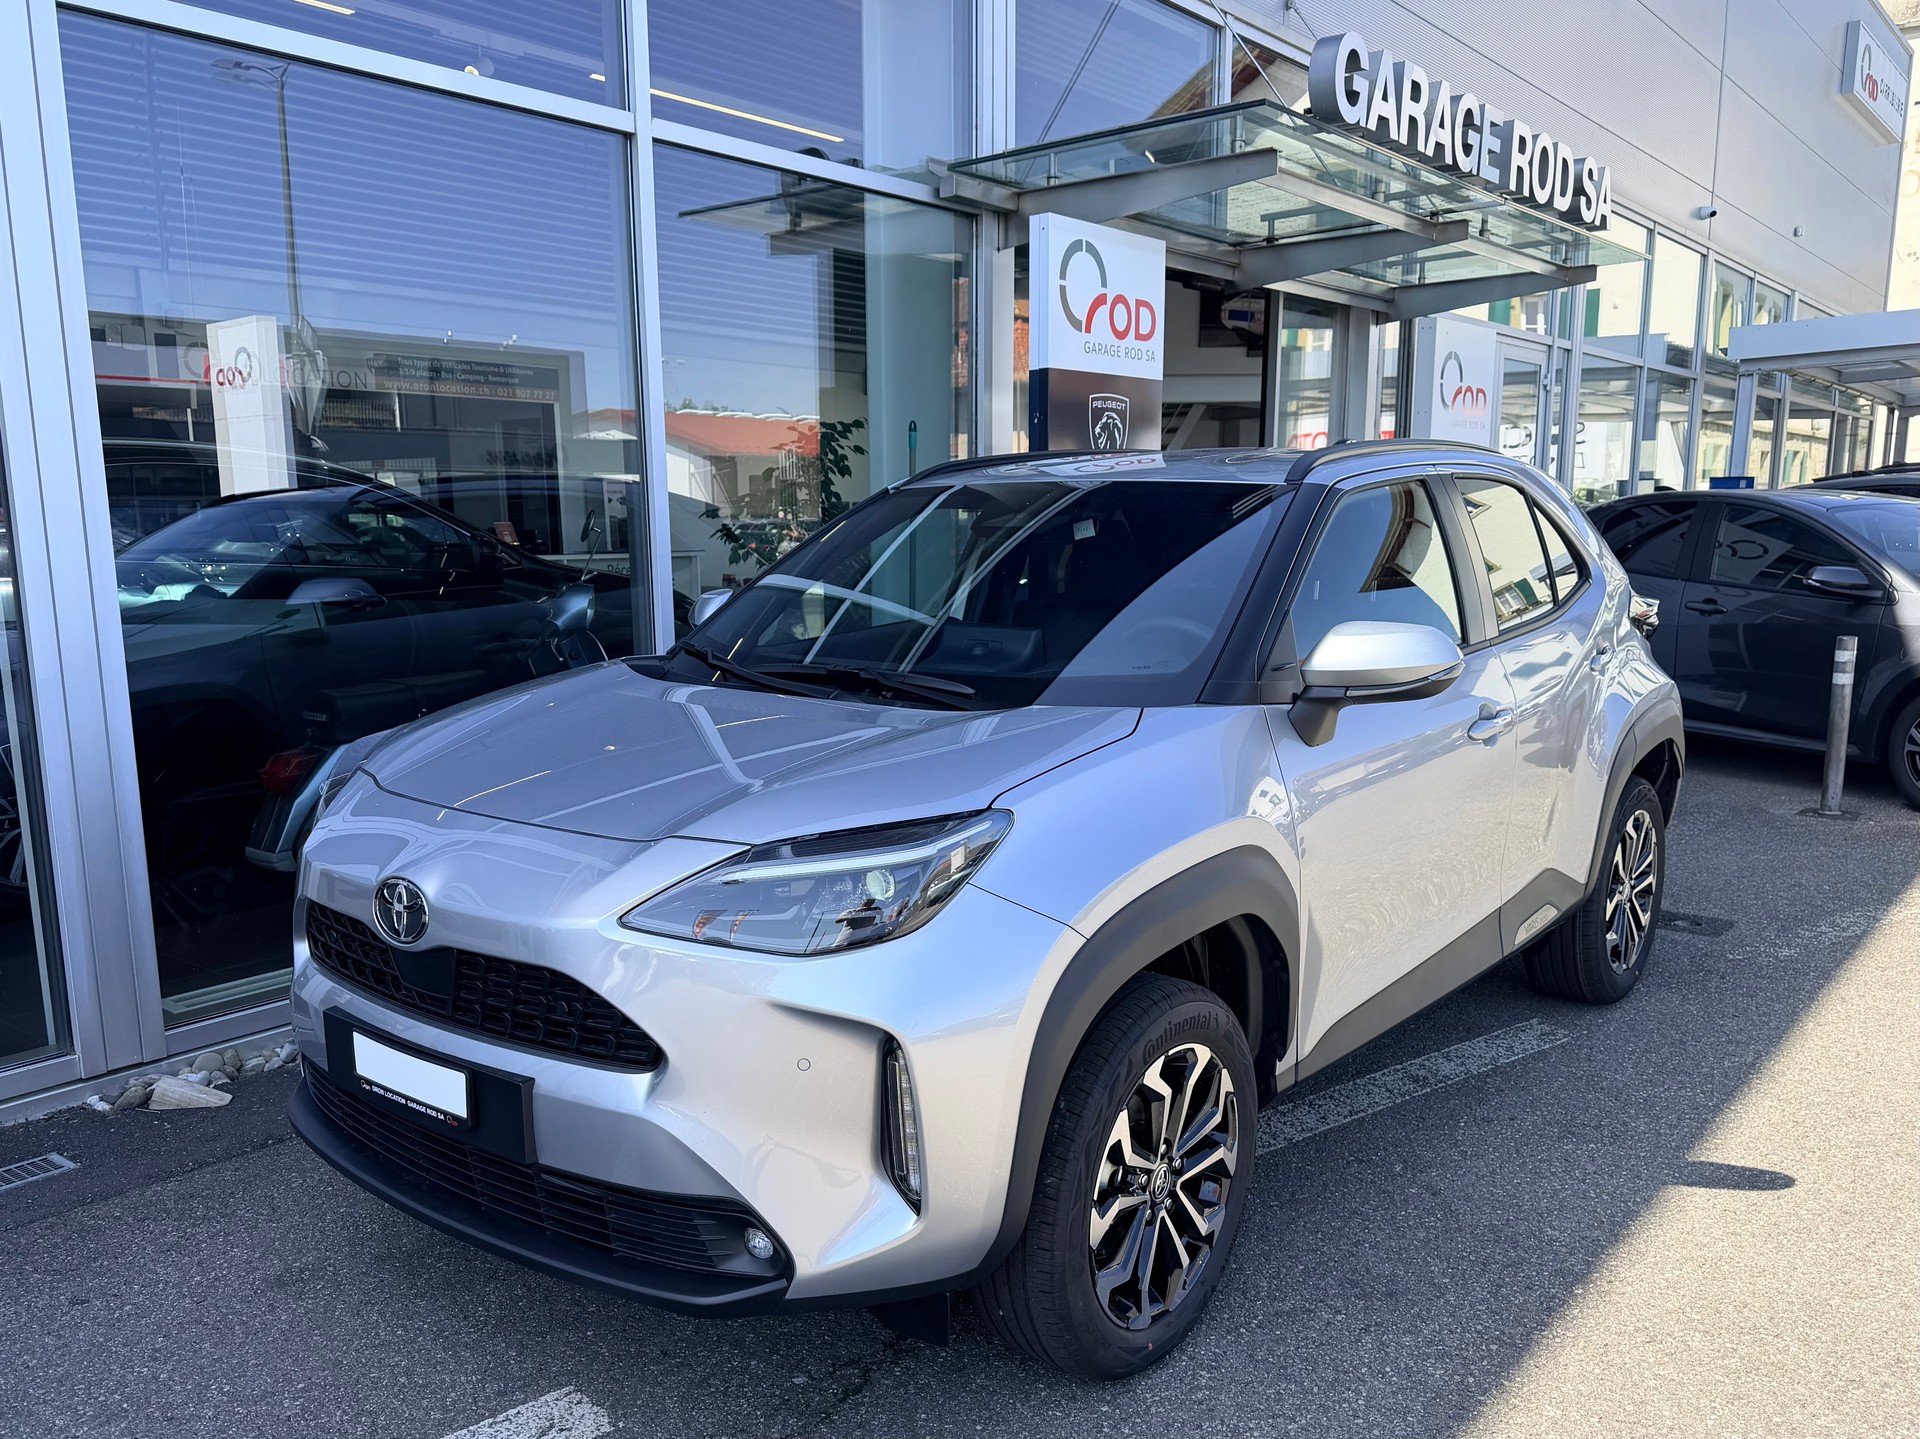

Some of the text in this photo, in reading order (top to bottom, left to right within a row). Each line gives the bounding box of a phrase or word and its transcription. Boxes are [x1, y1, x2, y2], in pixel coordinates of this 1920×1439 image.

[1333, 31, 1612, 230] GARAGE ROD SA
[1083, 341, 1156, 362] GARAGE ROD SA
[497, 387, 513, 397] 021
[1092, 400, 1126, 411] PEUGEOT
[1142, 1011, 1212, 1066] Continental
[385, 1091, 406, 1104] LOCATION
[407, 1100, 426, 1113] GARAGE
[427, 1108, 437, 1117] ROD
